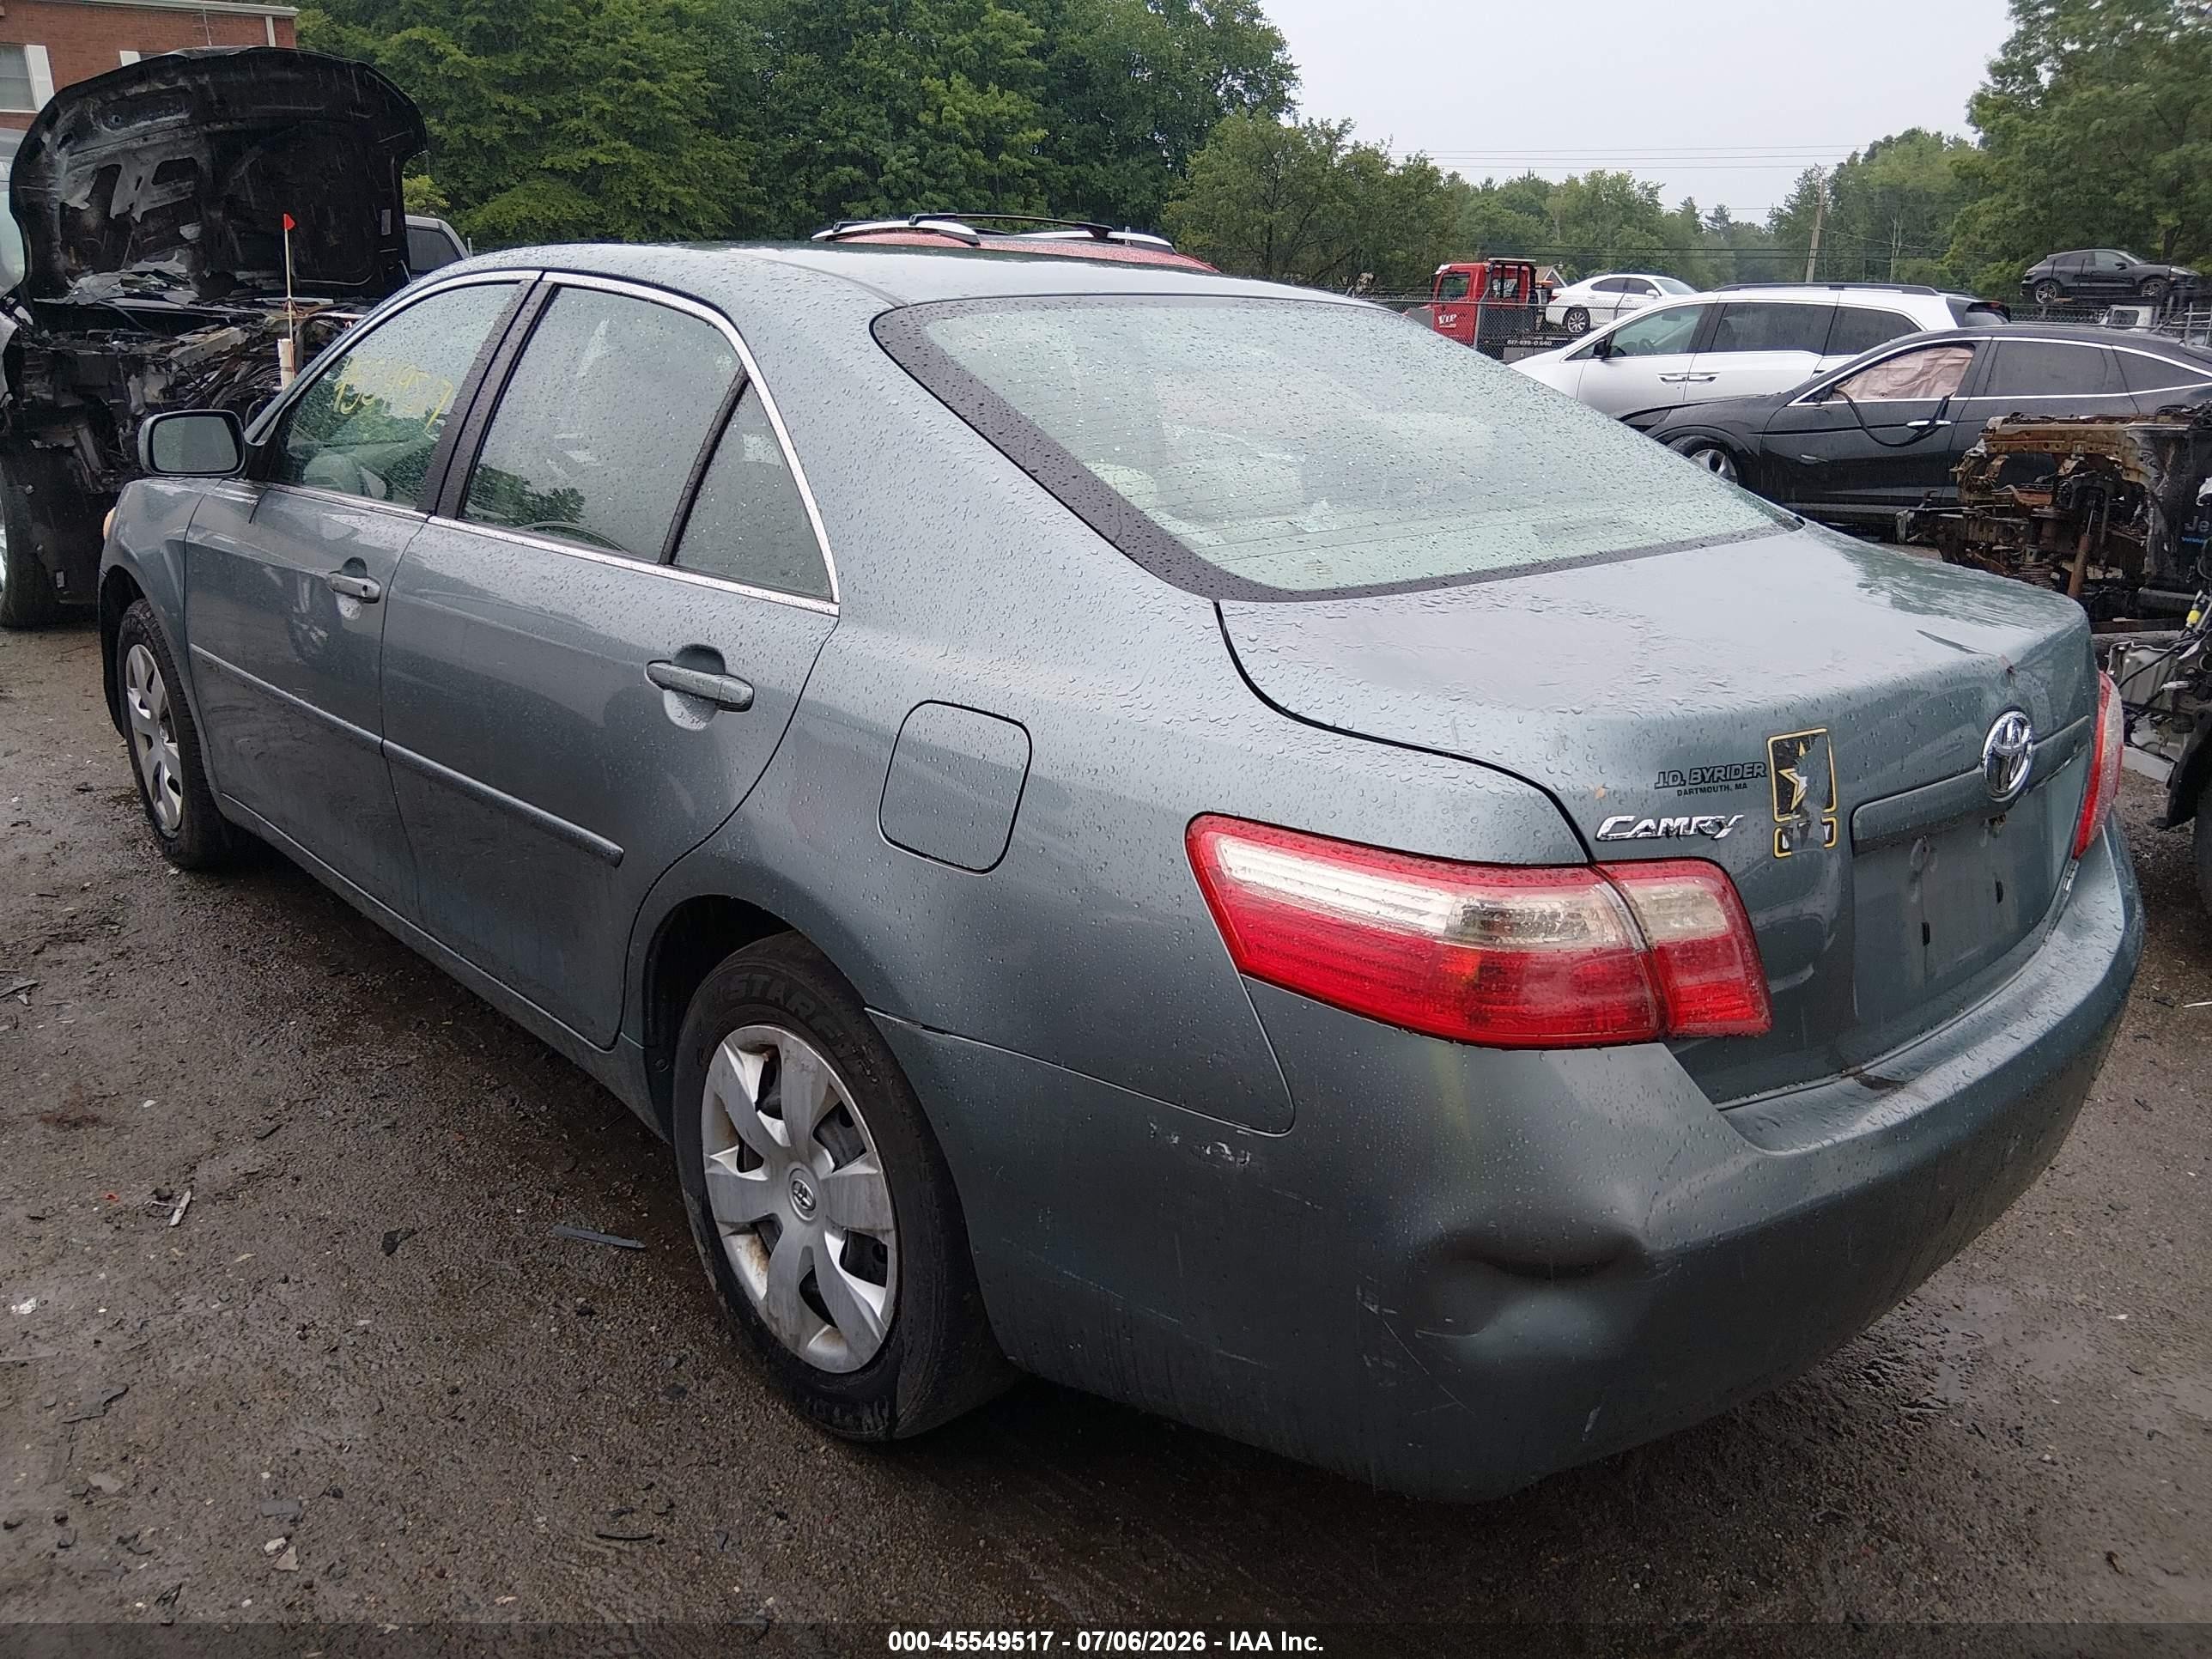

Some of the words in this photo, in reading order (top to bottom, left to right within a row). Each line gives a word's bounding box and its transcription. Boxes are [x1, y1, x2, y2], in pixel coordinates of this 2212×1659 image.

[1437, 313, 1457, 325] VIP
[1654, 770, 1686, 789] J.D.
[1688, 762, 1767, 785] BYRIDER
[1735, 782, 1748, 791] MA
[1595, 814, 1744, 842] CAMRY
